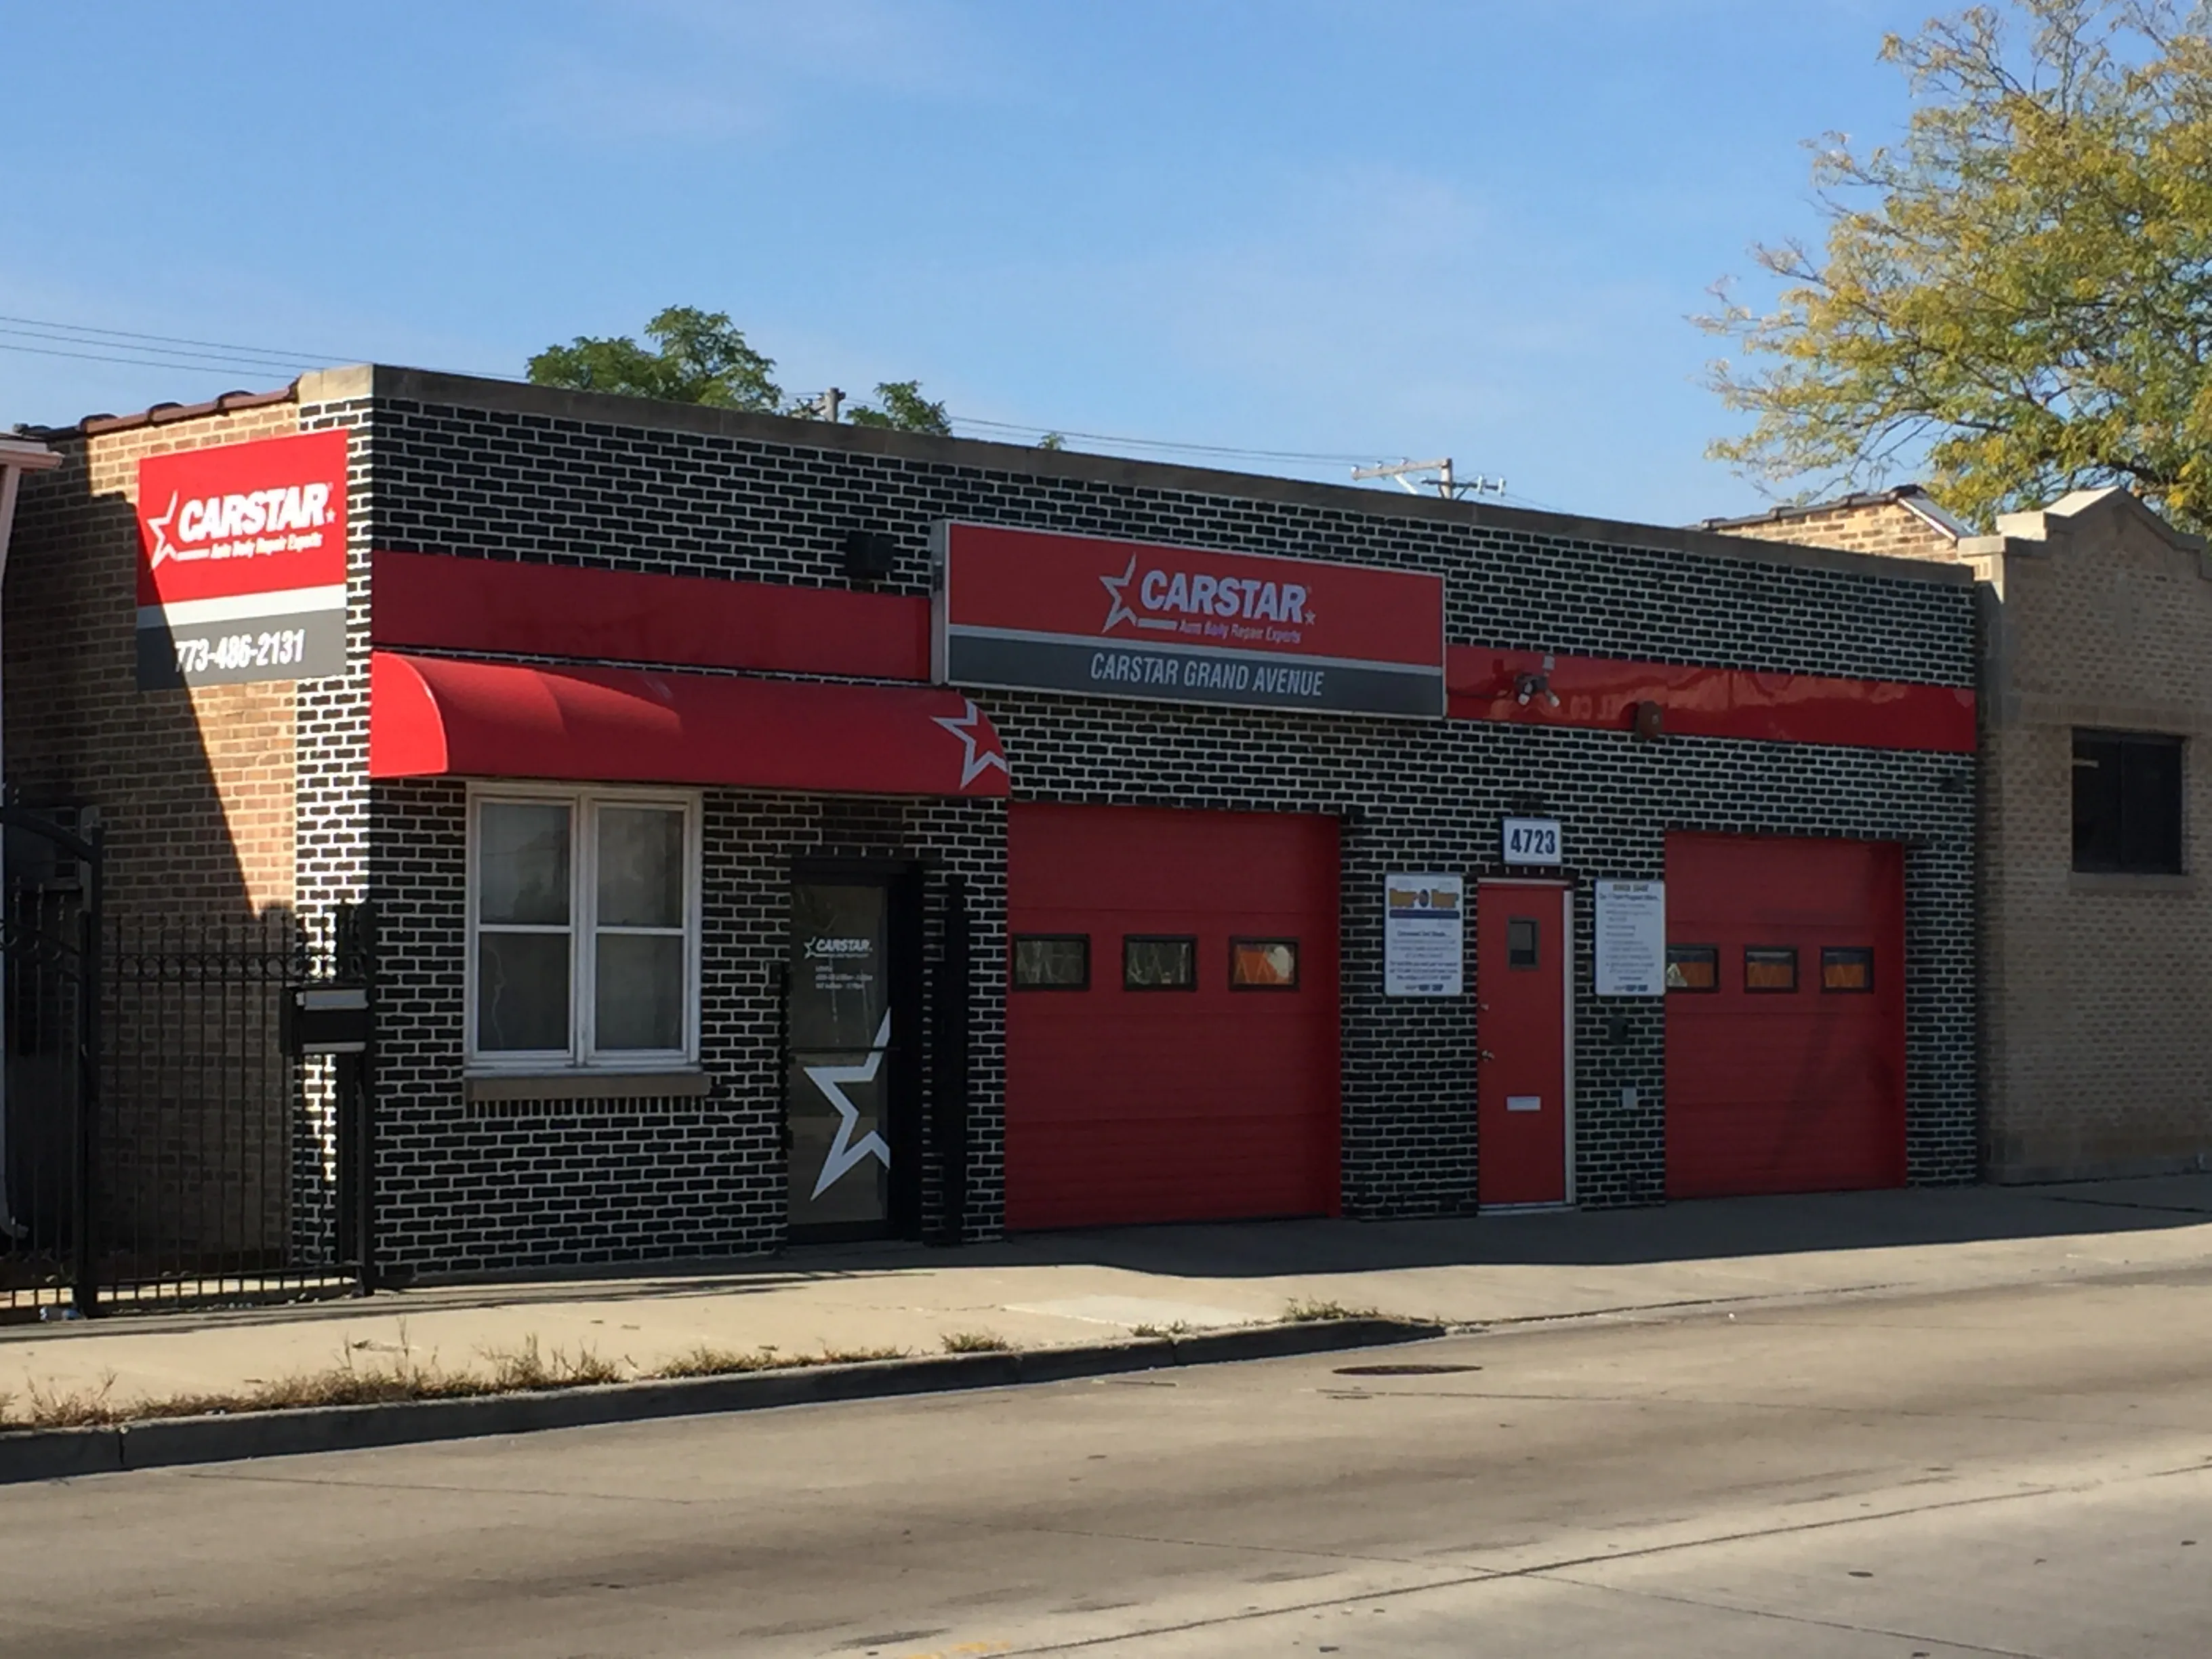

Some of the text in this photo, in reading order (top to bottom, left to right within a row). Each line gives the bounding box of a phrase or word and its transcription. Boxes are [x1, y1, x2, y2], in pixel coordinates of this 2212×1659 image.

[178, 483, 329, 543] CARSTAR
[1141, 569, 1307, 624] CARSTAR
[1090, 652, 1324, 696] CARSTAR GRAND AVENUE
[1510, 828, 1555, 855] 4723
[816, 939, 870, 952] CARSTAR
